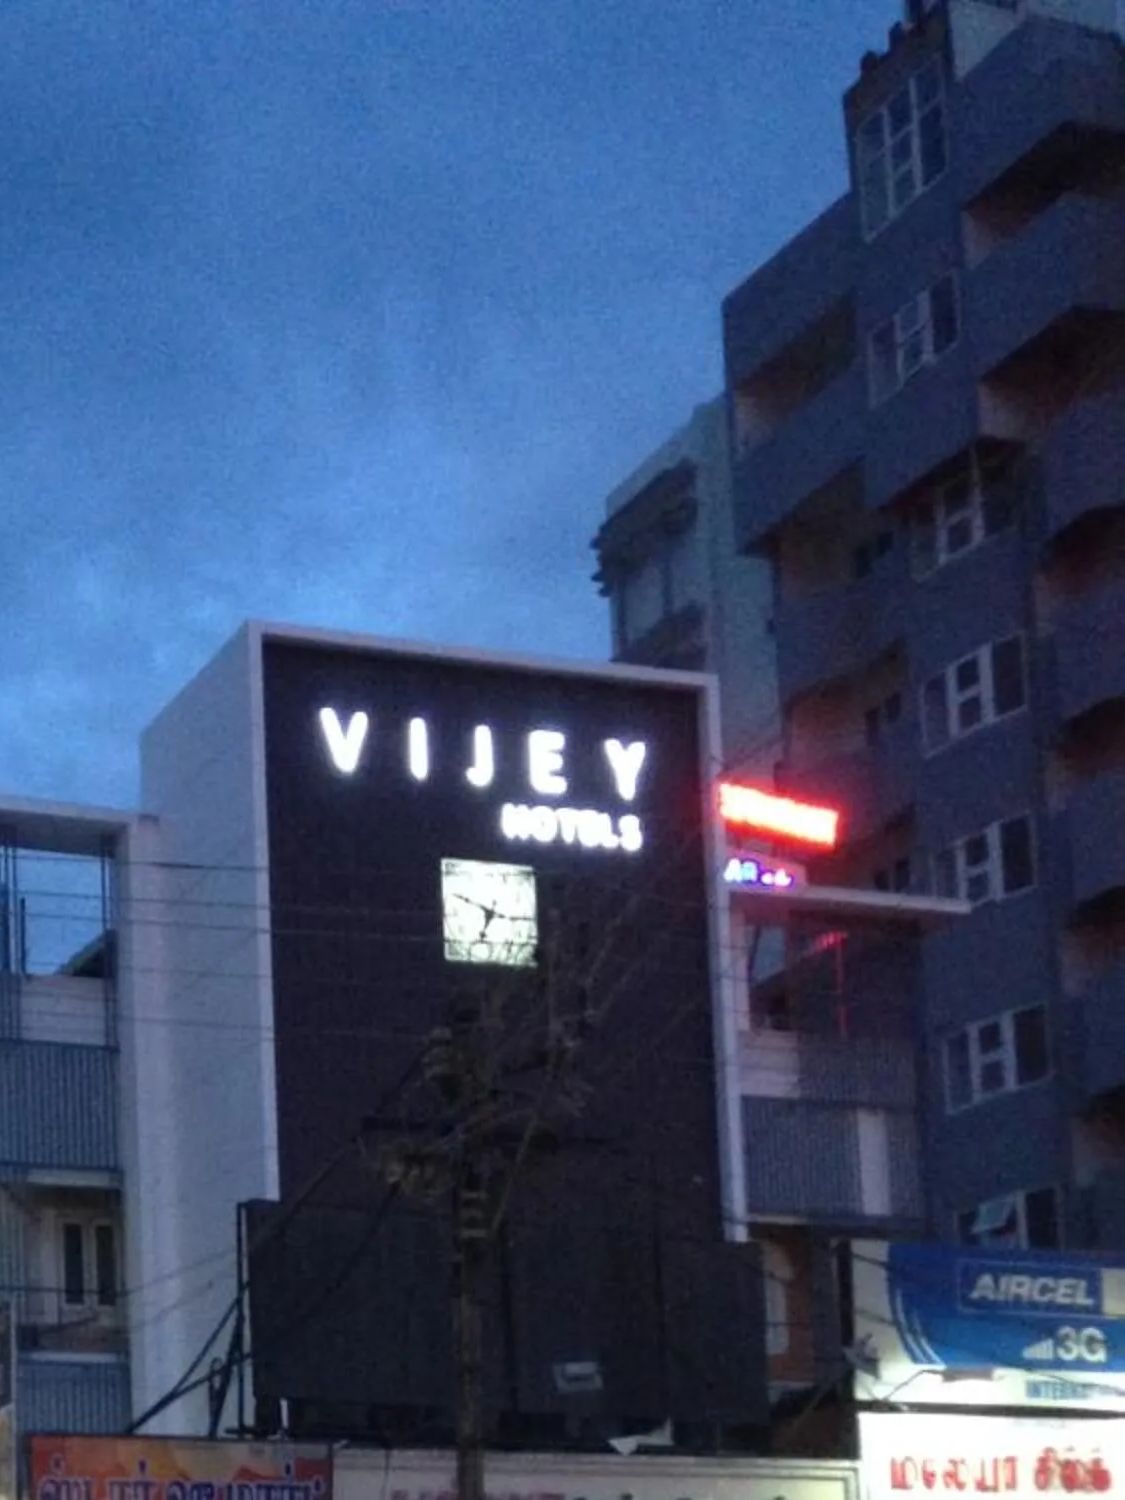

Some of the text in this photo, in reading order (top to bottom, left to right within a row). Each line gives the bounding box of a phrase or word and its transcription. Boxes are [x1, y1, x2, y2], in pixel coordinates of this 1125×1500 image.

[318, 707, 647, 801] VIJEY
[500, 802, 644, 851] HOTELS
[969, 1272, 1094, 1306] AIRCEL
[1056, 1325, 1107, 1362] 3G
